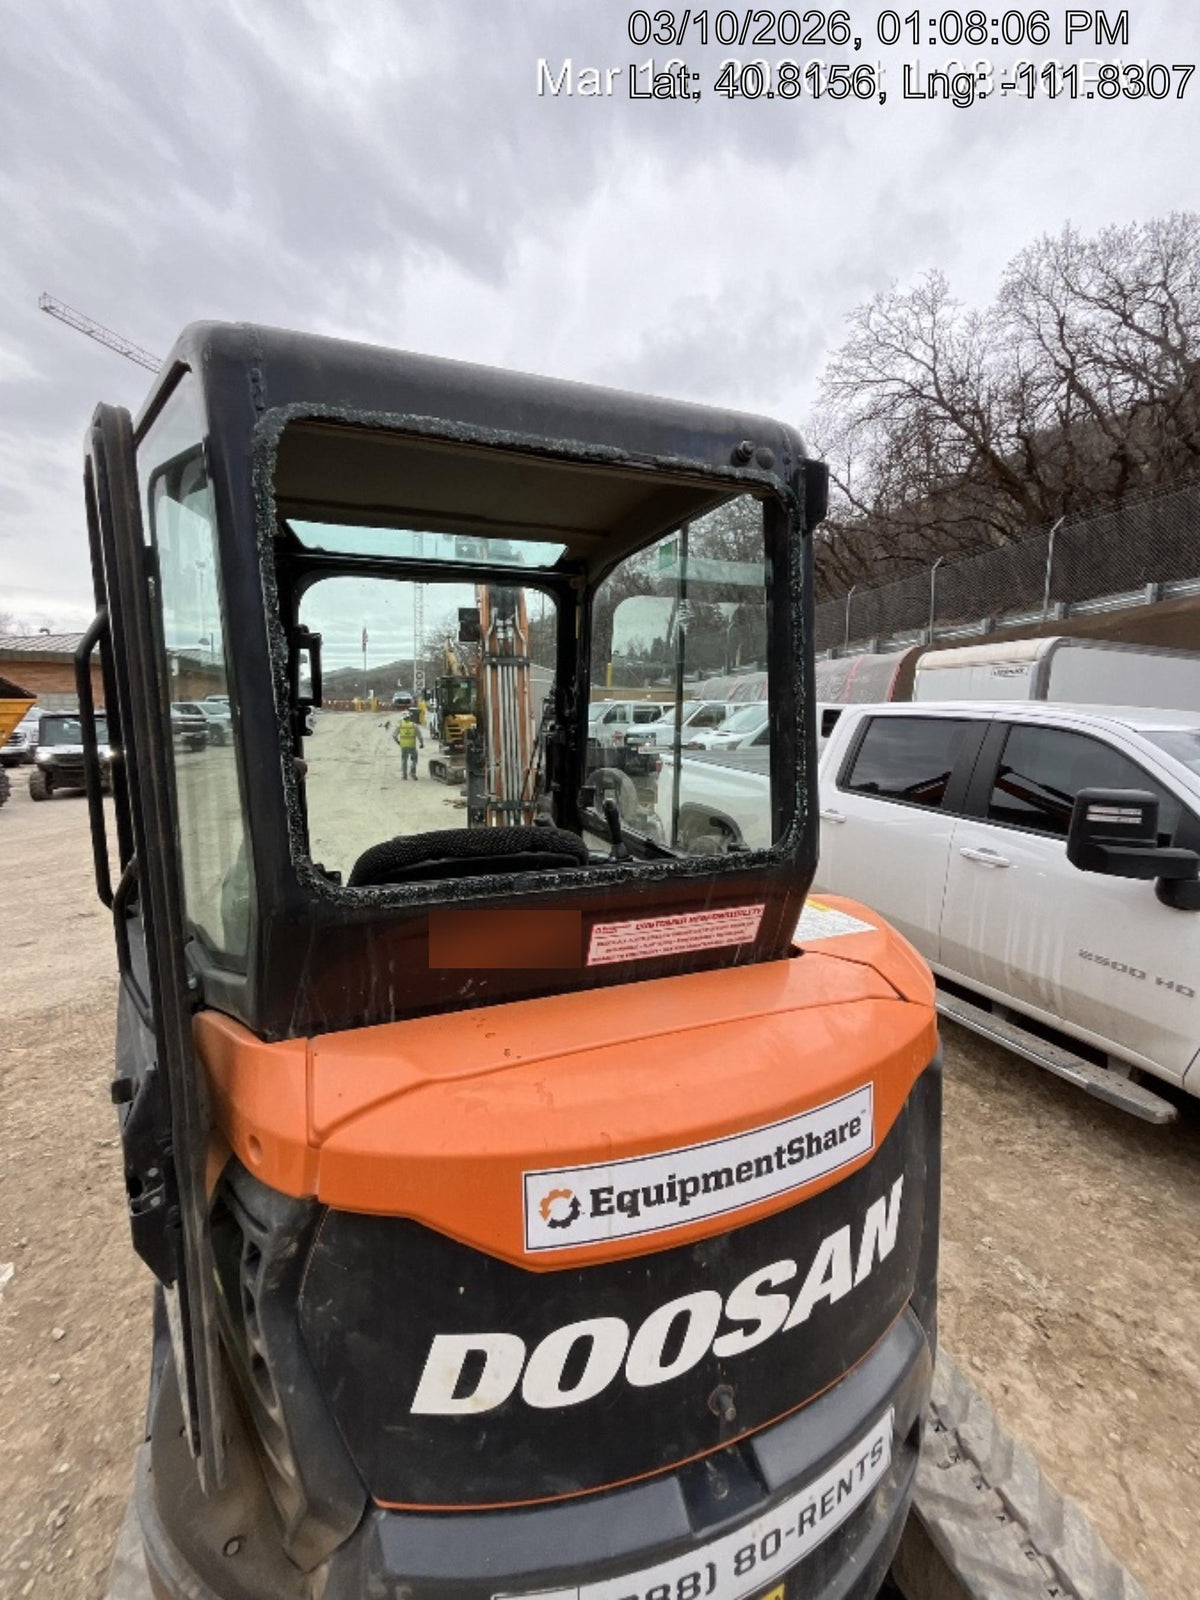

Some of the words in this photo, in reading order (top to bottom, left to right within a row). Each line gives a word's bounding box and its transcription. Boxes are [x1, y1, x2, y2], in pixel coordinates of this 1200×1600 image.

[1078, 948, 1147, 980] 2500
[1155, 976, 1196, 998] HD
[589, 1115, 862, 1218] EquipmentShare
[410, 1174, 904, 1415] DOOSAN
[733, 1436, 884, 1577] 80-RENTS
